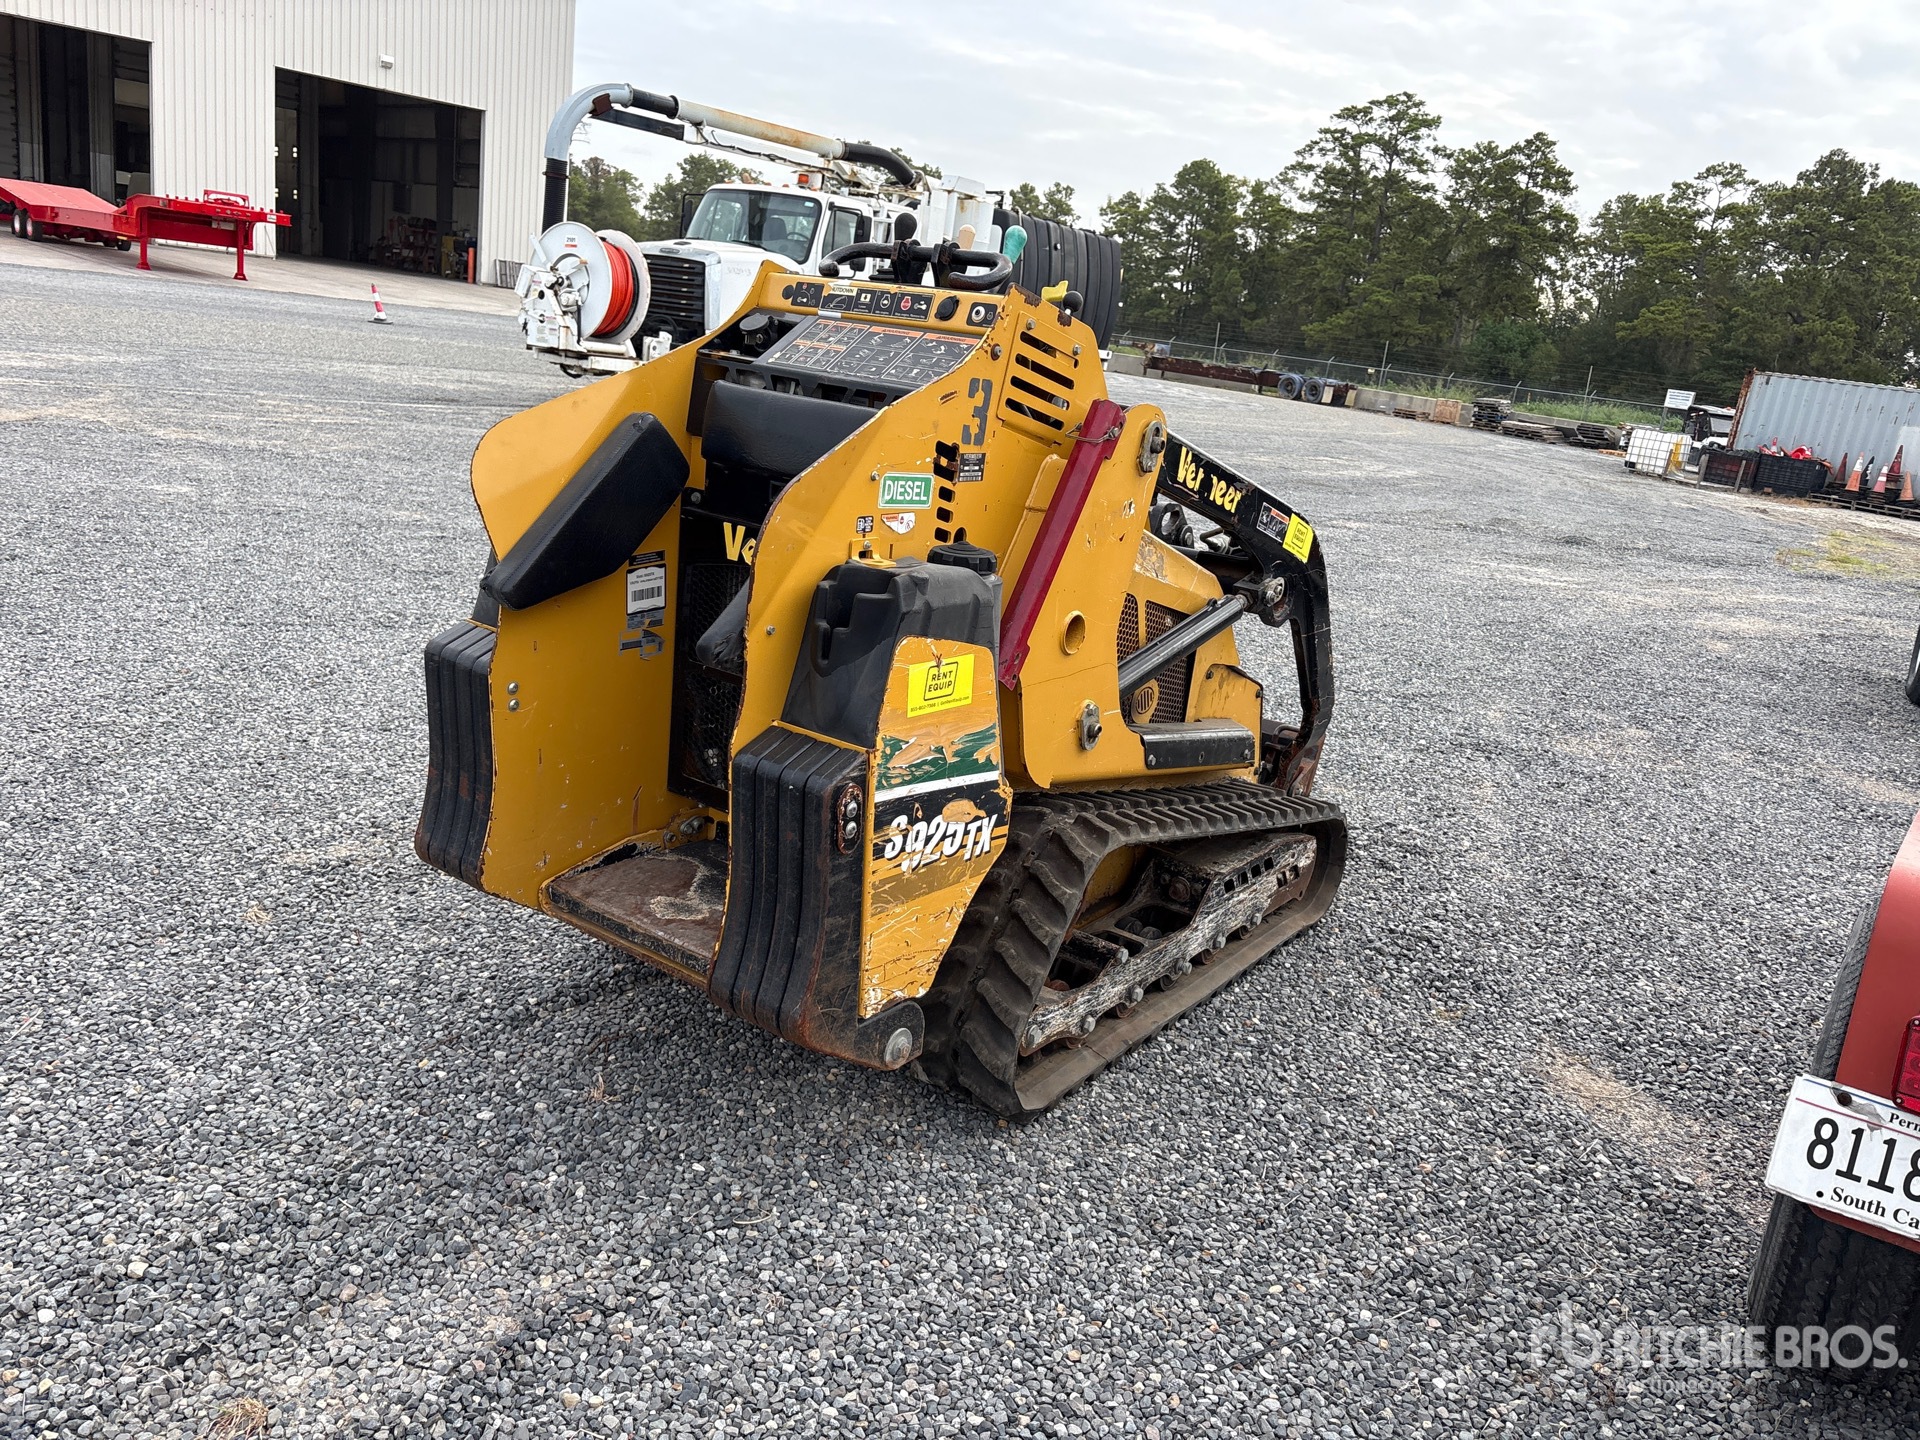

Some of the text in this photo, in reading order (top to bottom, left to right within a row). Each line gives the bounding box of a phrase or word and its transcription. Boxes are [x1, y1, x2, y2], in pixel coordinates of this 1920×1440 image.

[961, 378, 993, 446] 3
[884, 480, 928, 501] DIESEL
[928, 680, 953, 692] EQUIP
[931, 670, 953, 682] RENT
[1830, 1186, 1886, 1218] South
